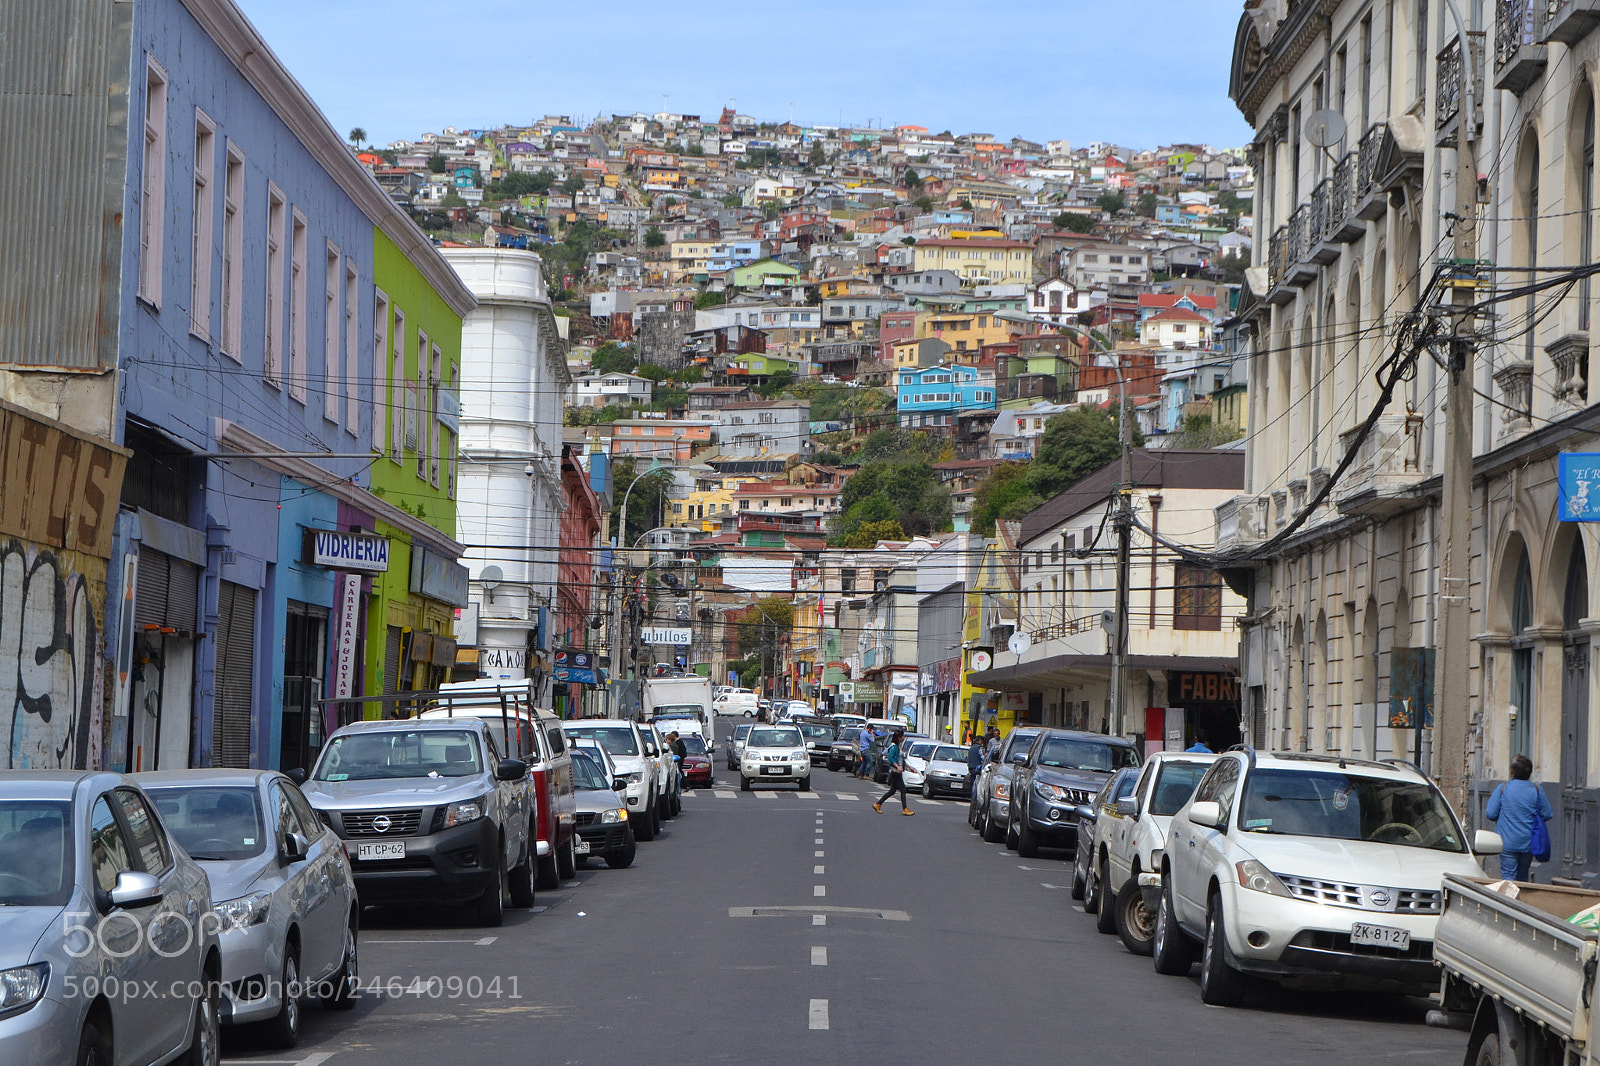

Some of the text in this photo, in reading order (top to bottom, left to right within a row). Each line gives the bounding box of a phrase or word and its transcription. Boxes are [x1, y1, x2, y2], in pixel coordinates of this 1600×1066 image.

[316, 532, 387, 563] VIDRIERIA
[345, 581, 355, 644] CARTERAS
[643, 629, 689, 643] ubillos
